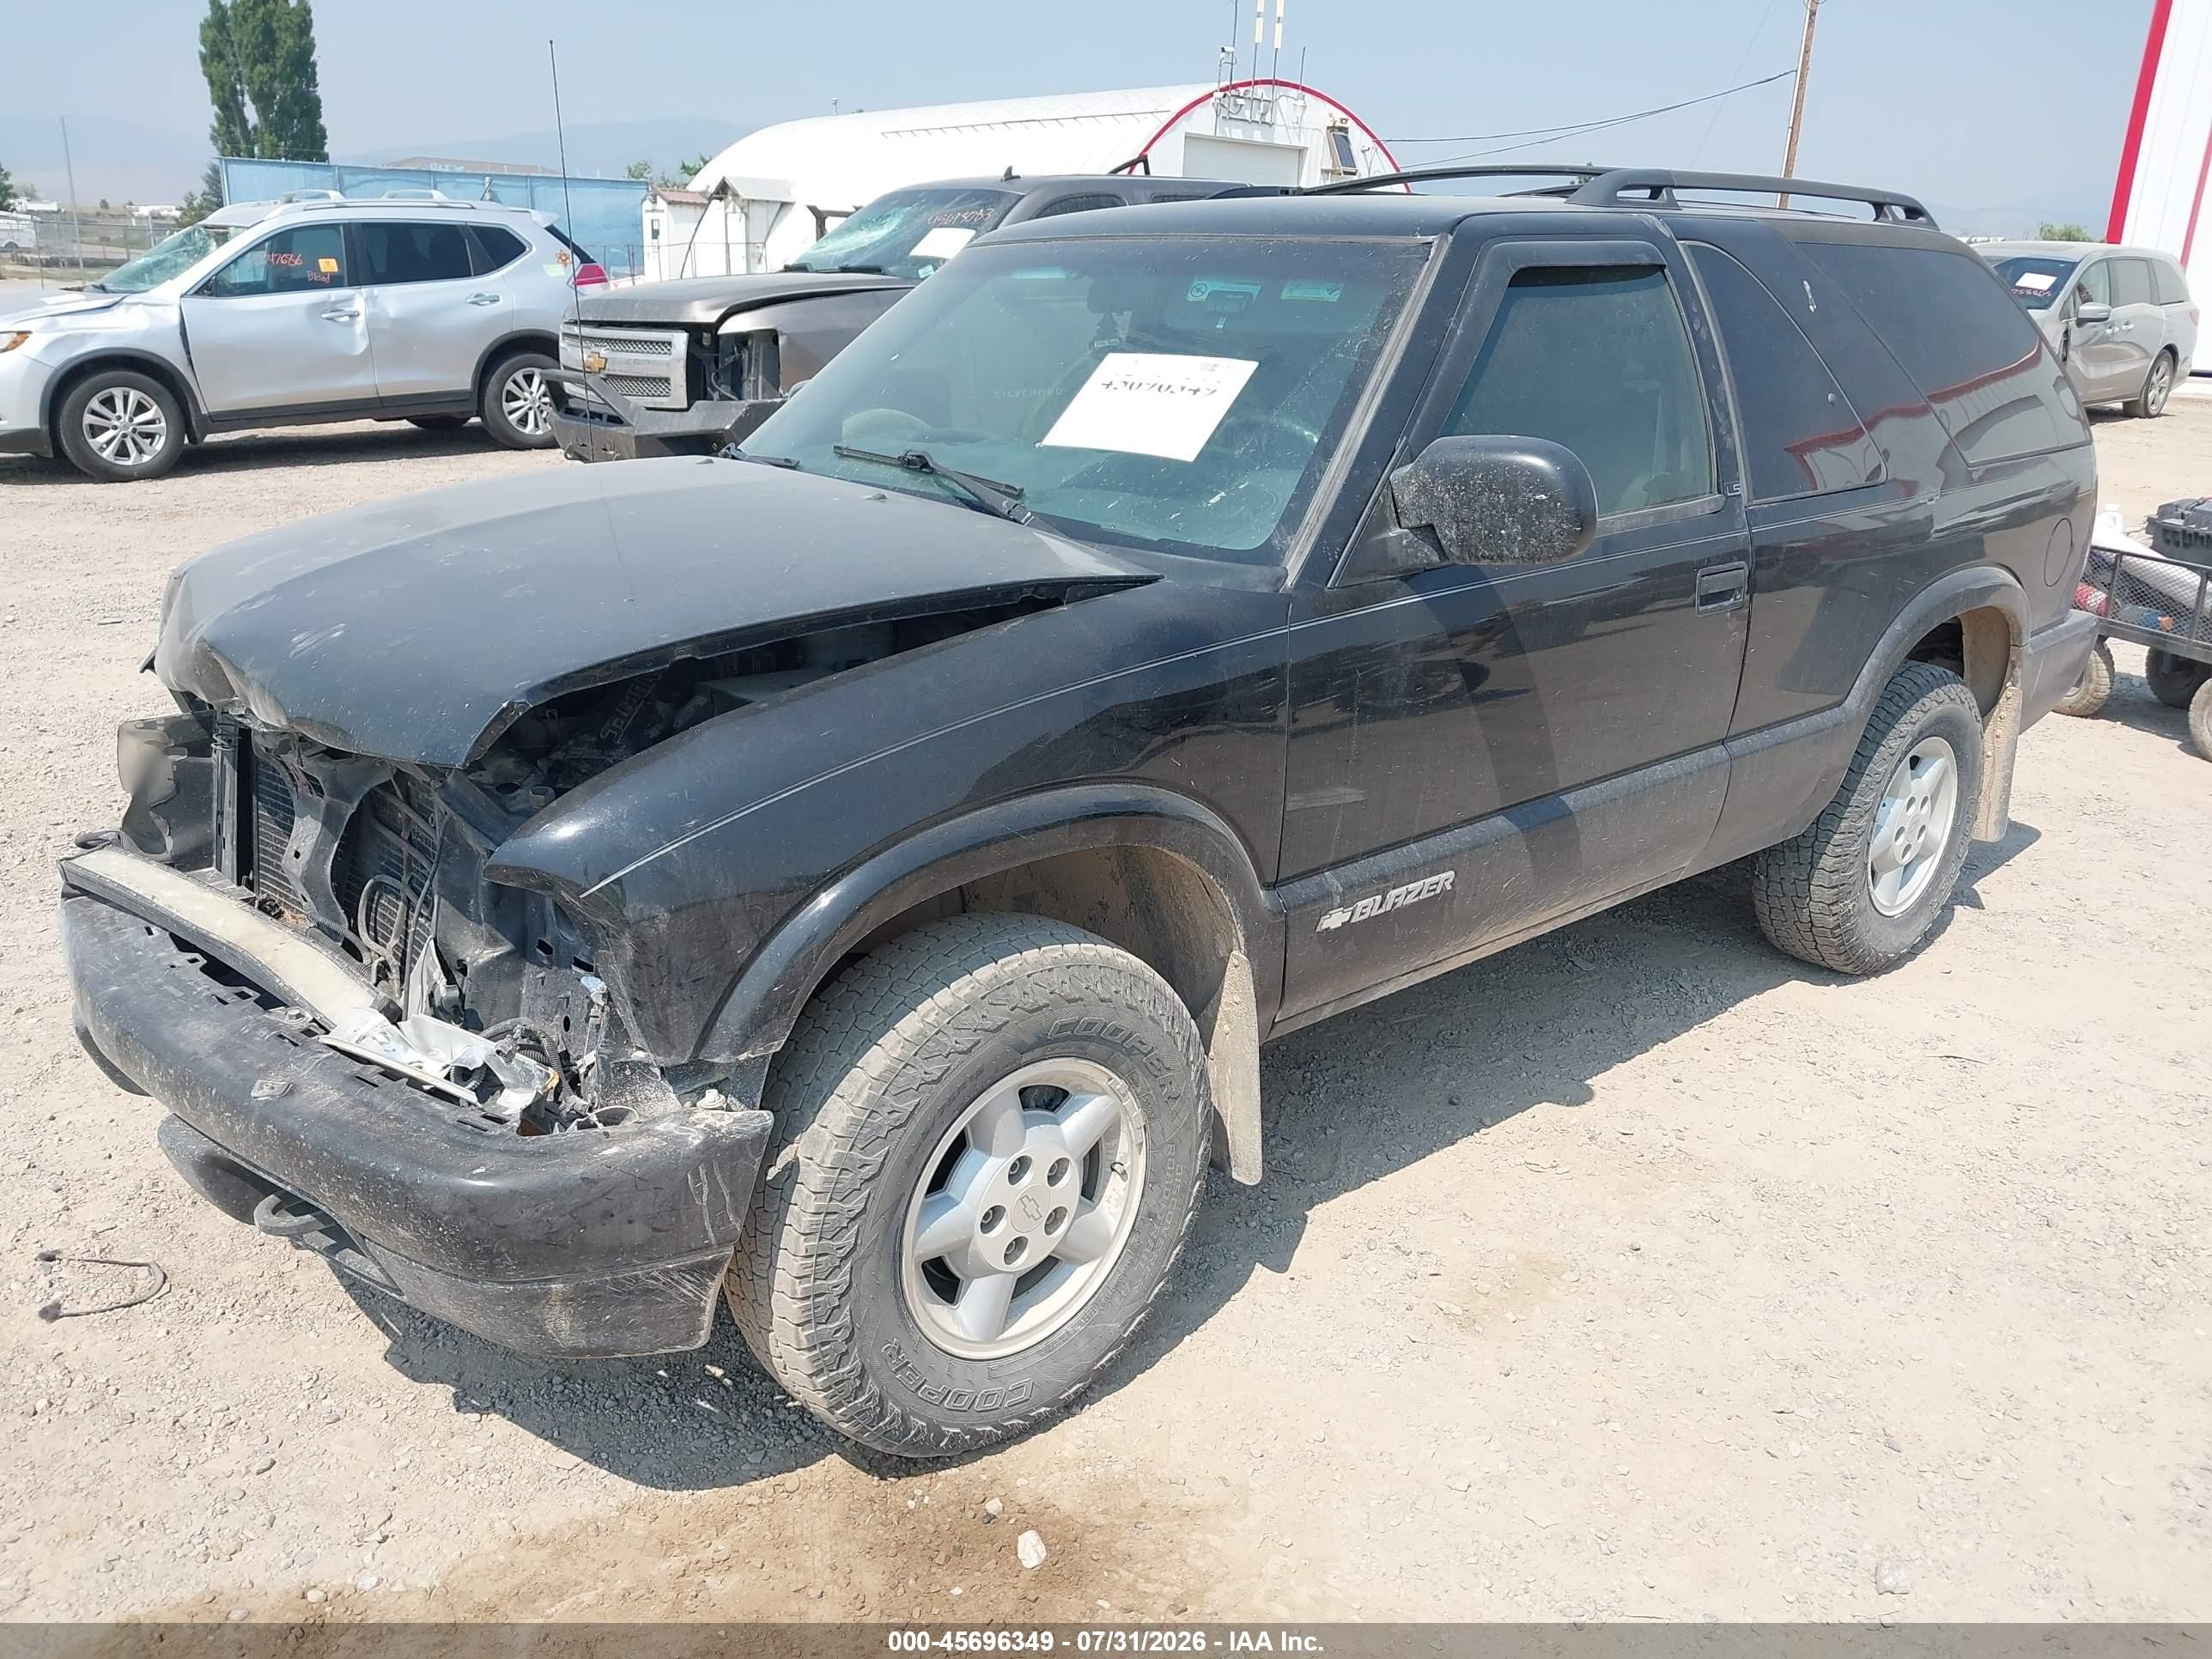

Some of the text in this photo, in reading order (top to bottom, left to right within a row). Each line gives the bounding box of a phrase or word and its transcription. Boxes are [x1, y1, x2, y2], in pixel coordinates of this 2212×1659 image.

[1726, 483, 1741, 495] LS
[1349, 870, 1456, 923] BLAZER
[1047, 1017, 1182, 1101] COOPER
[880, 1337, 1034, 1412] COOPER
